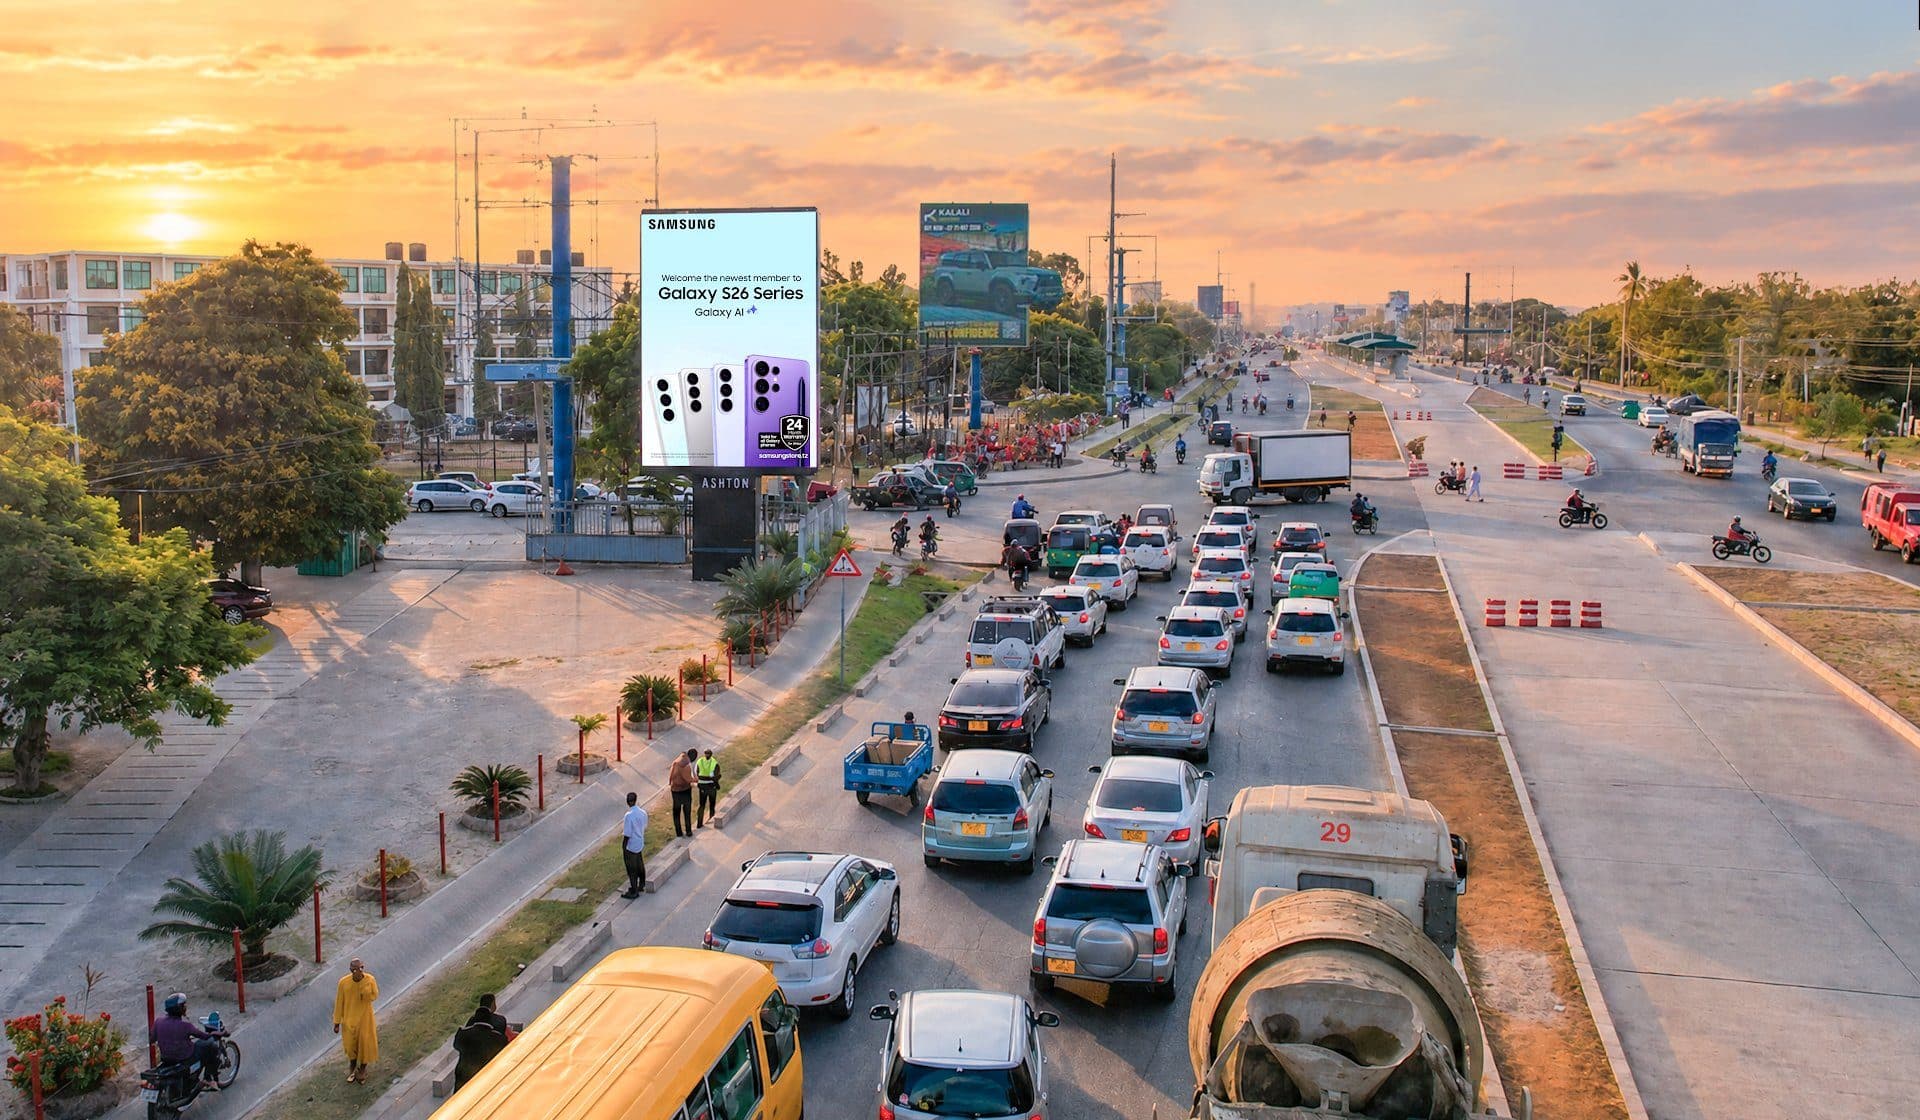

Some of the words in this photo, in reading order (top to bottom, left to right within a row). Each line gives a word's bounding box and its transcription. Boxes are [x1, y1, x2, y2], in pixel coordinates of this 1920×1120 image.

[938, 208, 970, 216] KALALI
[648, 218, 716, 230] SAMSUNG
[661, 274, 702, 283] Welcome
[703, 274, 718, 283] the
[719, 275, 752, 283] newest
[753, 274, 791, 283] member
[792, 275, 802, 283] to
[658, 286, 718, 304] Galaxy
[721, 286, 750, 300] S26
[753, 285, 804, 300] Series
[694, 307, 732, 319] Galaxy
[734, 307, 744, 317] AI
[786, 418, 804, 430] 24
[701, 477, 750, 489] ASHTON
[1320, 822, 1351, 843] 29
